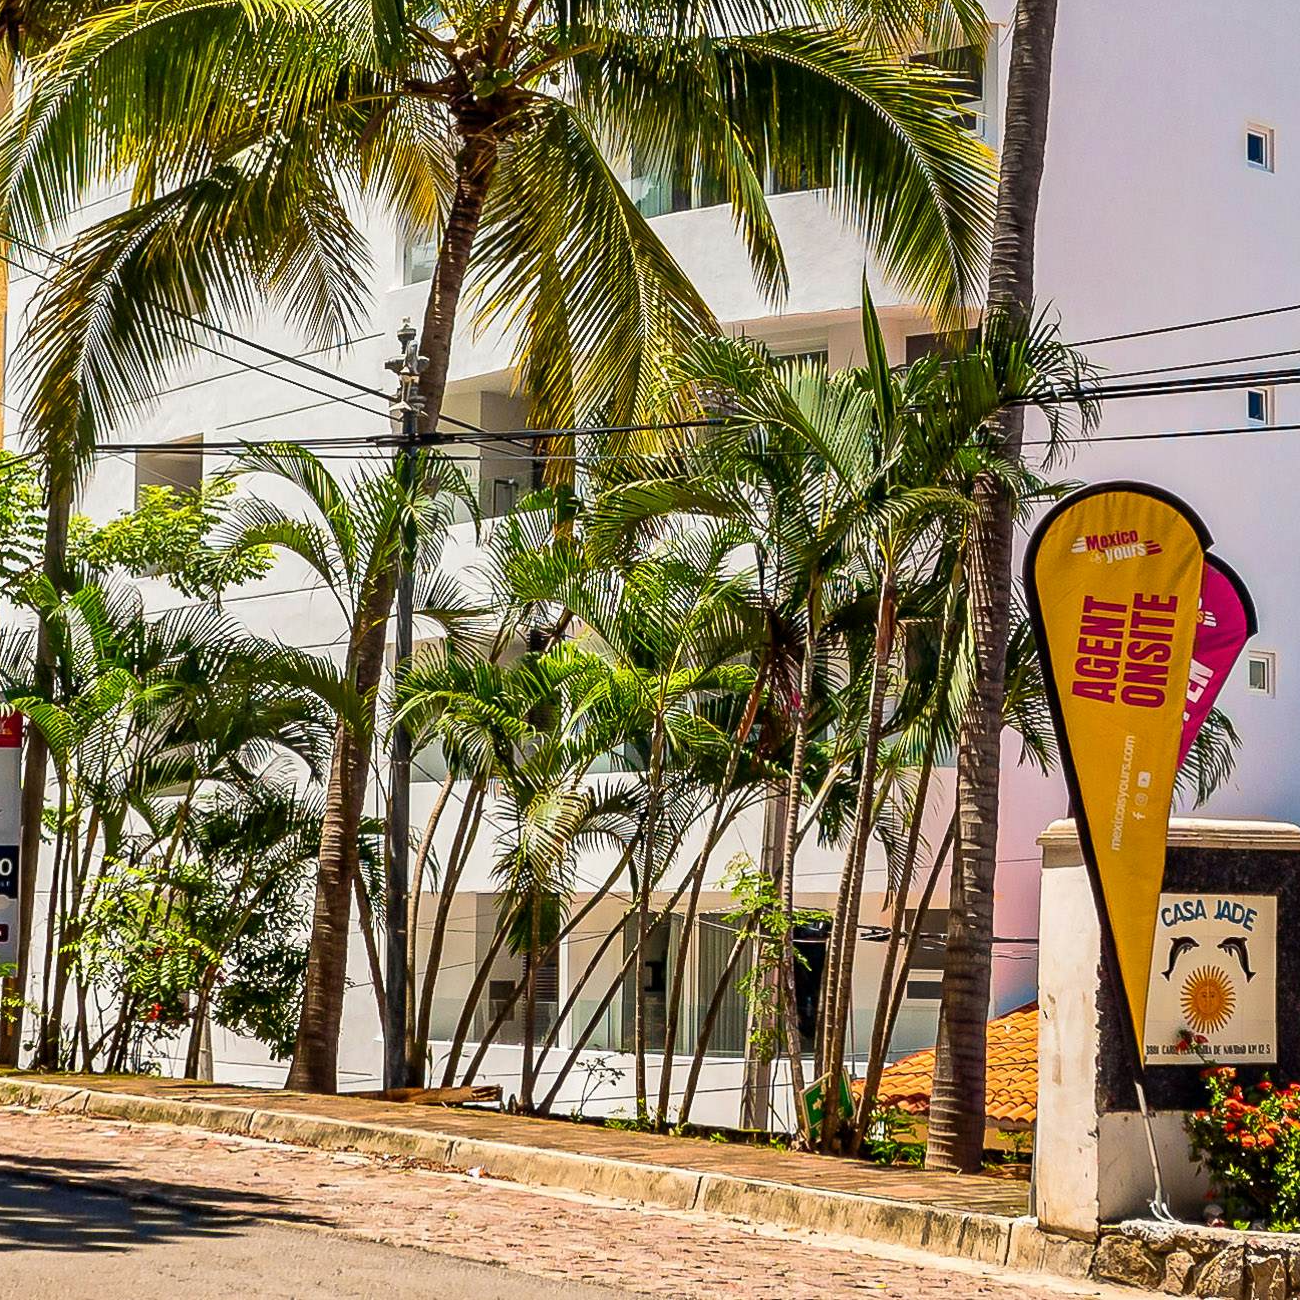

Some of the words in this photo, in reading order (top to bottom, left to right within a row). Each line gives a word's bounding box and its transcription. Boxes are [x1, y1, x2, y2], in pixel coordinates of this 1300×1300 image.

[1085, 529, 1139, 553] Mexico
[1105, 542, 1147, 564] yours
[1071, 595, 1128, 705] AGENT
[1120, 592, 1179, 709] ONSITE
[1110, 735, 1136, 851] mexicoisyours.com
[1161, 899, 1208, 928] CASA
[1213, 899, 1258, 932] JADE
